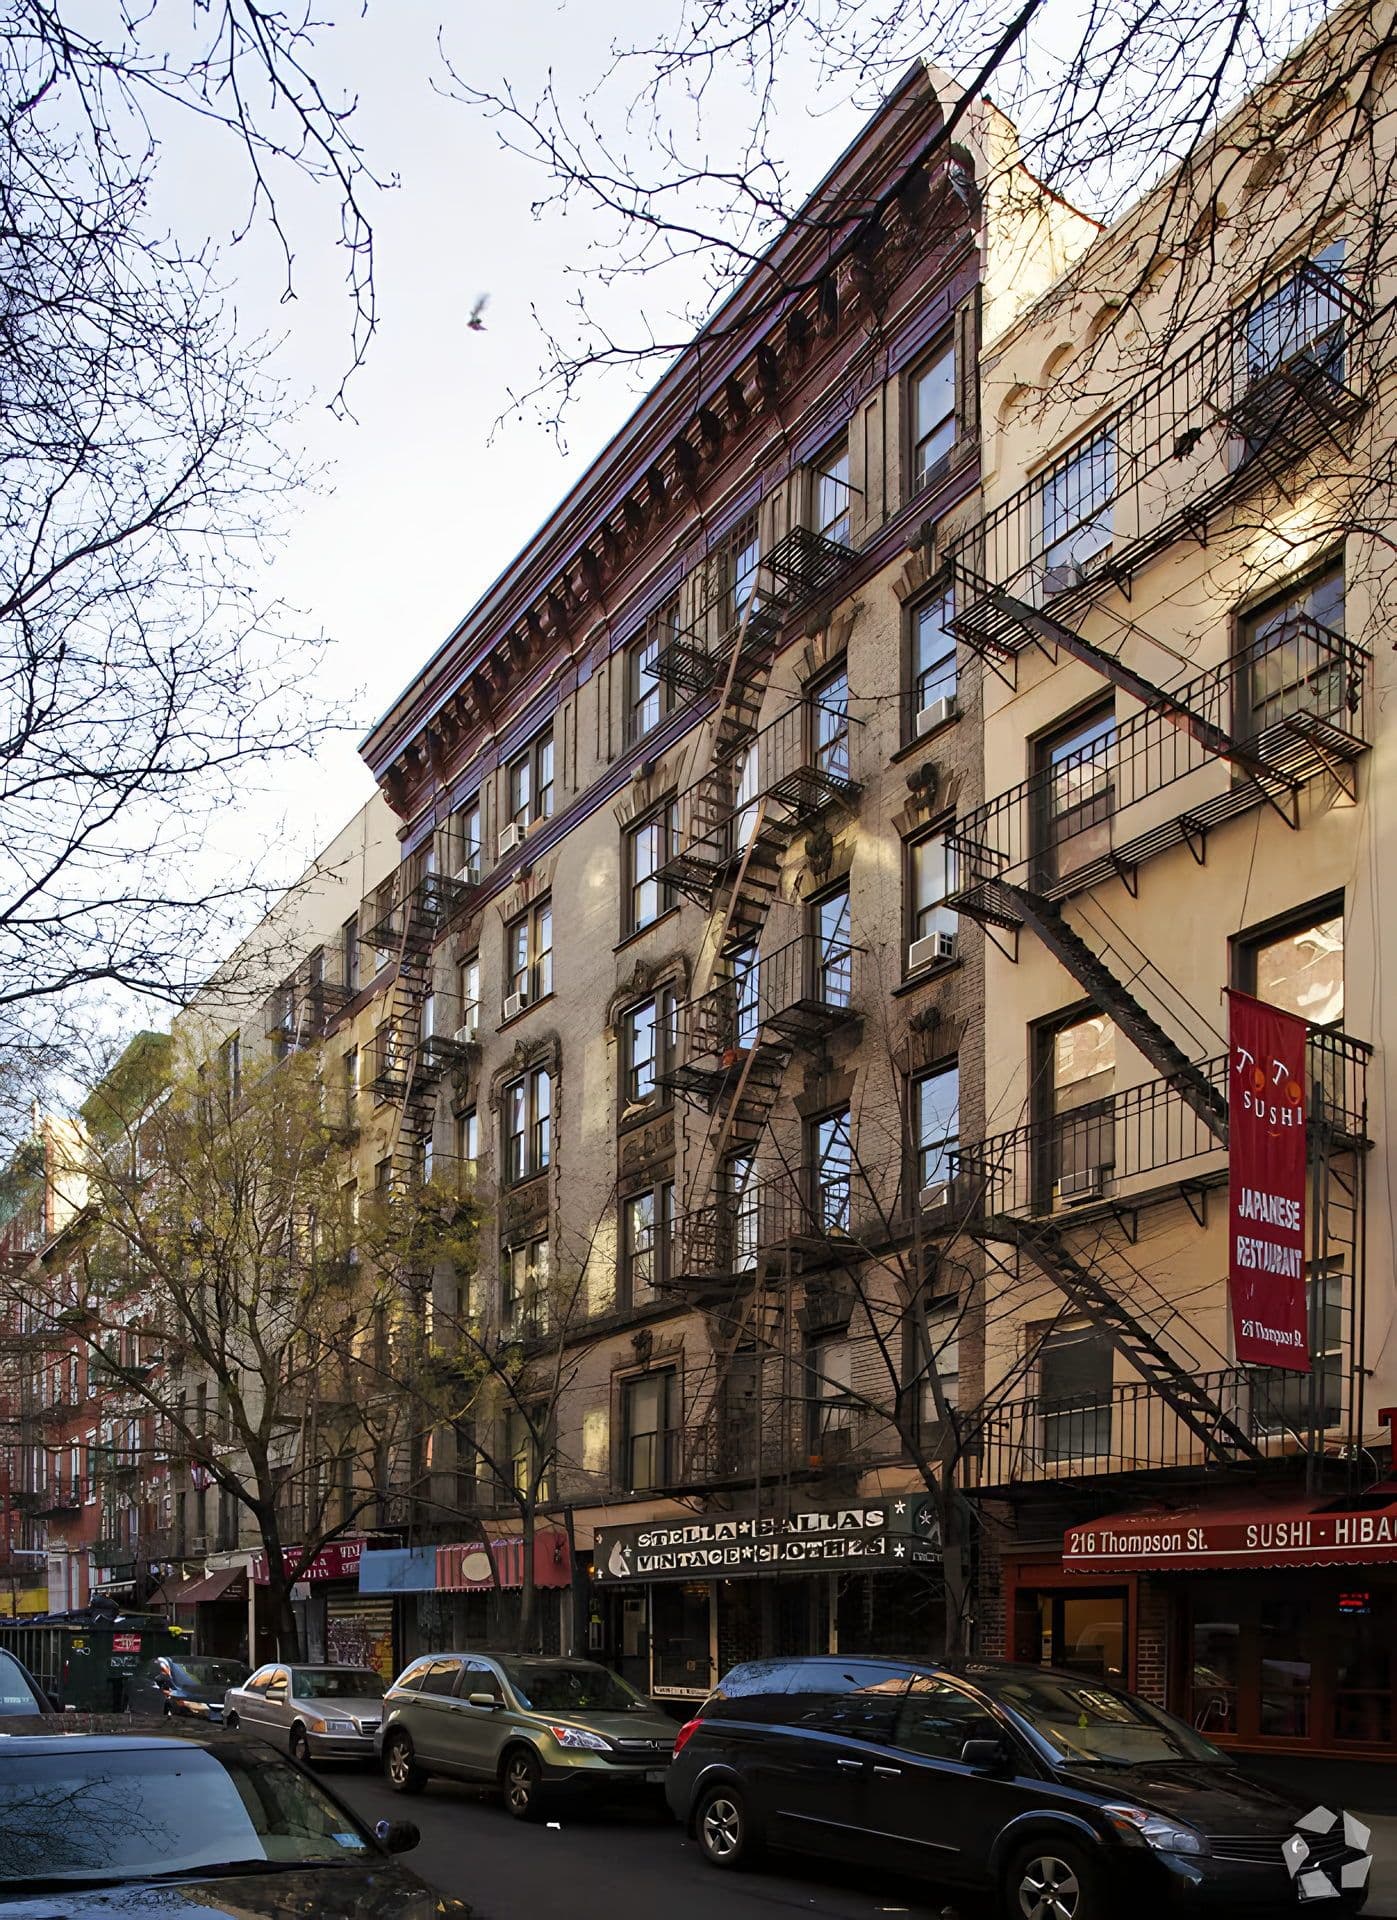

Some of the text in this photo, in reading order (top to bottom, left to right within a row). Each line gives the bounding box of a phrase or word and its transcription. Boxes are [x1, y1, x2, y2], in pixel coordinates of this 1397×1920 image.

[1244, 1090, 1302, 1126] SUSHI
[1238, 1187, 1300, 1231] JAPANESE
[637, 1522, 737, 1547] STELLA
[1070, 1516, 1397, 1554] 216 Thompson St. SUSHI HIBA
[637, 1547, 740, 1572] VINTAGE
